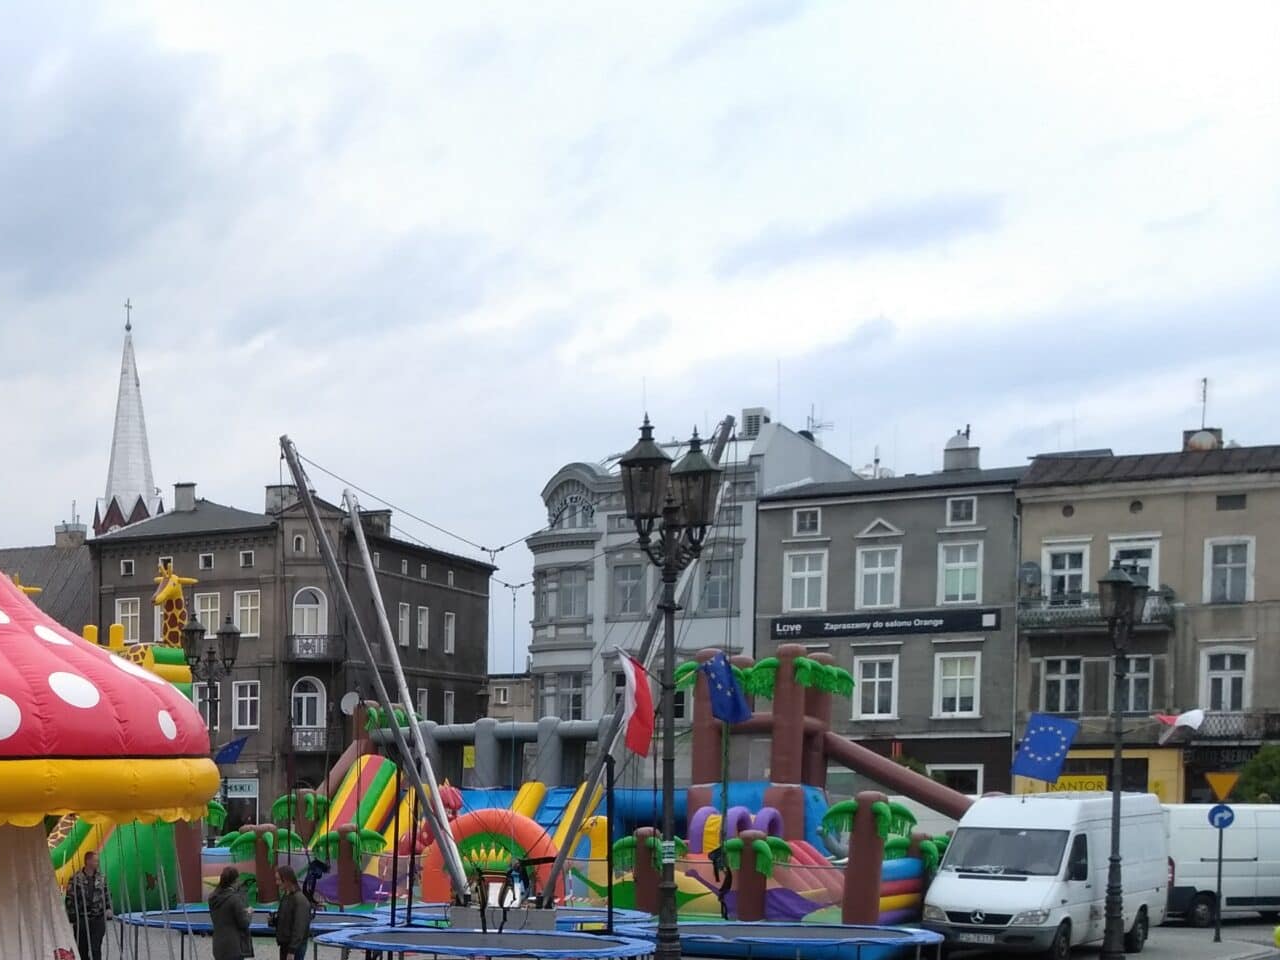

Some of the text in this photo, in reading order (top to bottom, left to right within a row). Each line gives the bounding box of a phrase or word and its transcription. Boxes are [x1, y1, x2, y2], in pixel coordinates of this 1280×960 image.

[776, 623, 802, 632] Love
[824, 618, 943, 631] Zapraszamy do salonu Orange
[1050, 780, 1105, 791] KANTOR
